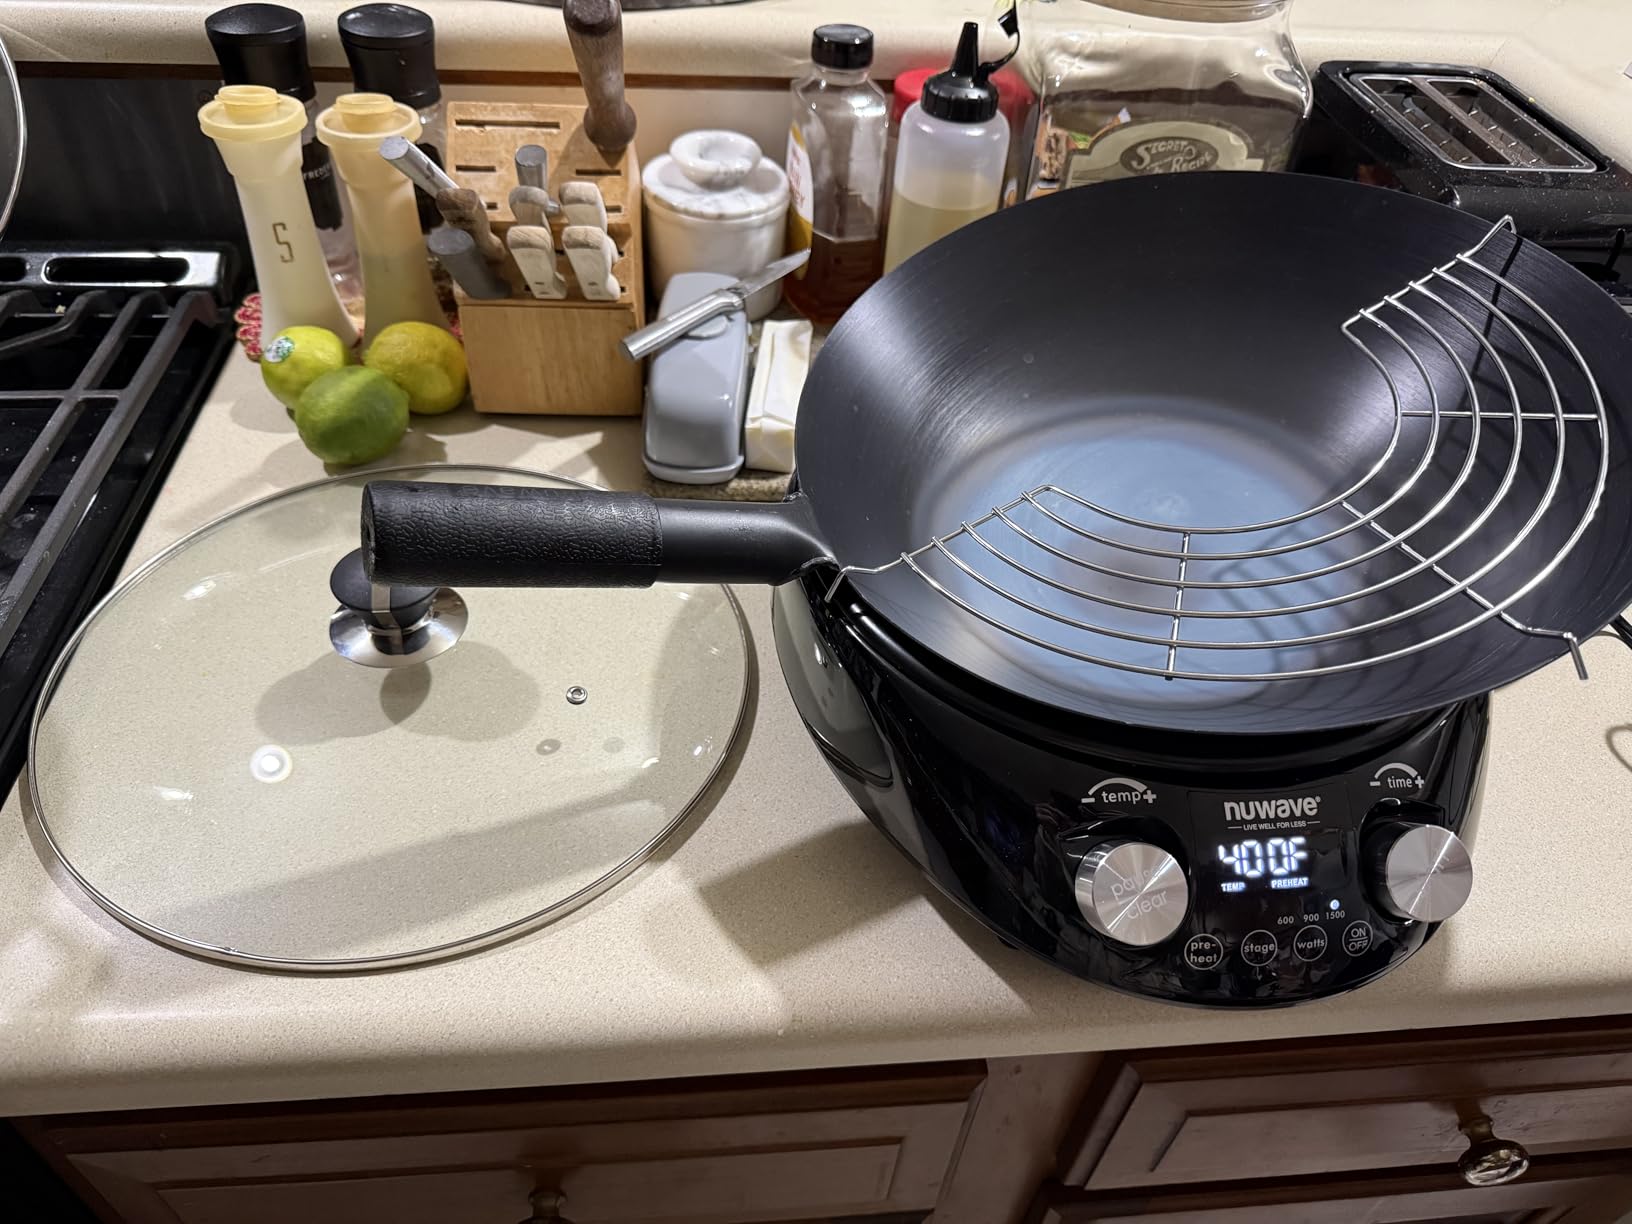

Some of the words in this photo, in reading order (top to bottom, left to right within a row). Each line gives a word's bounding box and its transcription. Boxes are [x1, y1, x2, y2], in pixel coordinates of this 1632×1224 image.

[272, 221, 295, 263] S
[1387, 777, 1413, 789] time
[1101, 790, 1141, 805] temp
[1258, 822, 1276, 830] WELL
[1276, 821, 1290, 829] FOR
[1290, 820, 1307, 828] LESS
[1217, 836, 1309, 878] 400F
[1220, 881, 1246, 893] TEMP
[1270, 876, 1309, 890] PREHEAT
[1277, 915, 1295, 926] 600
[1304, 913, 1320, 923] 900
[1325, 910, 1346, 920] 1500
[1350, 927, 1367, 938] ON
[1190, 940, 1217, 952] pre-
[1243, 942, 1276, 955] stage
[1297, 937, 1326, 950] watts
[1348, 940, 1368, 952] OFF
[1190, 952, 1218, 964] heat
